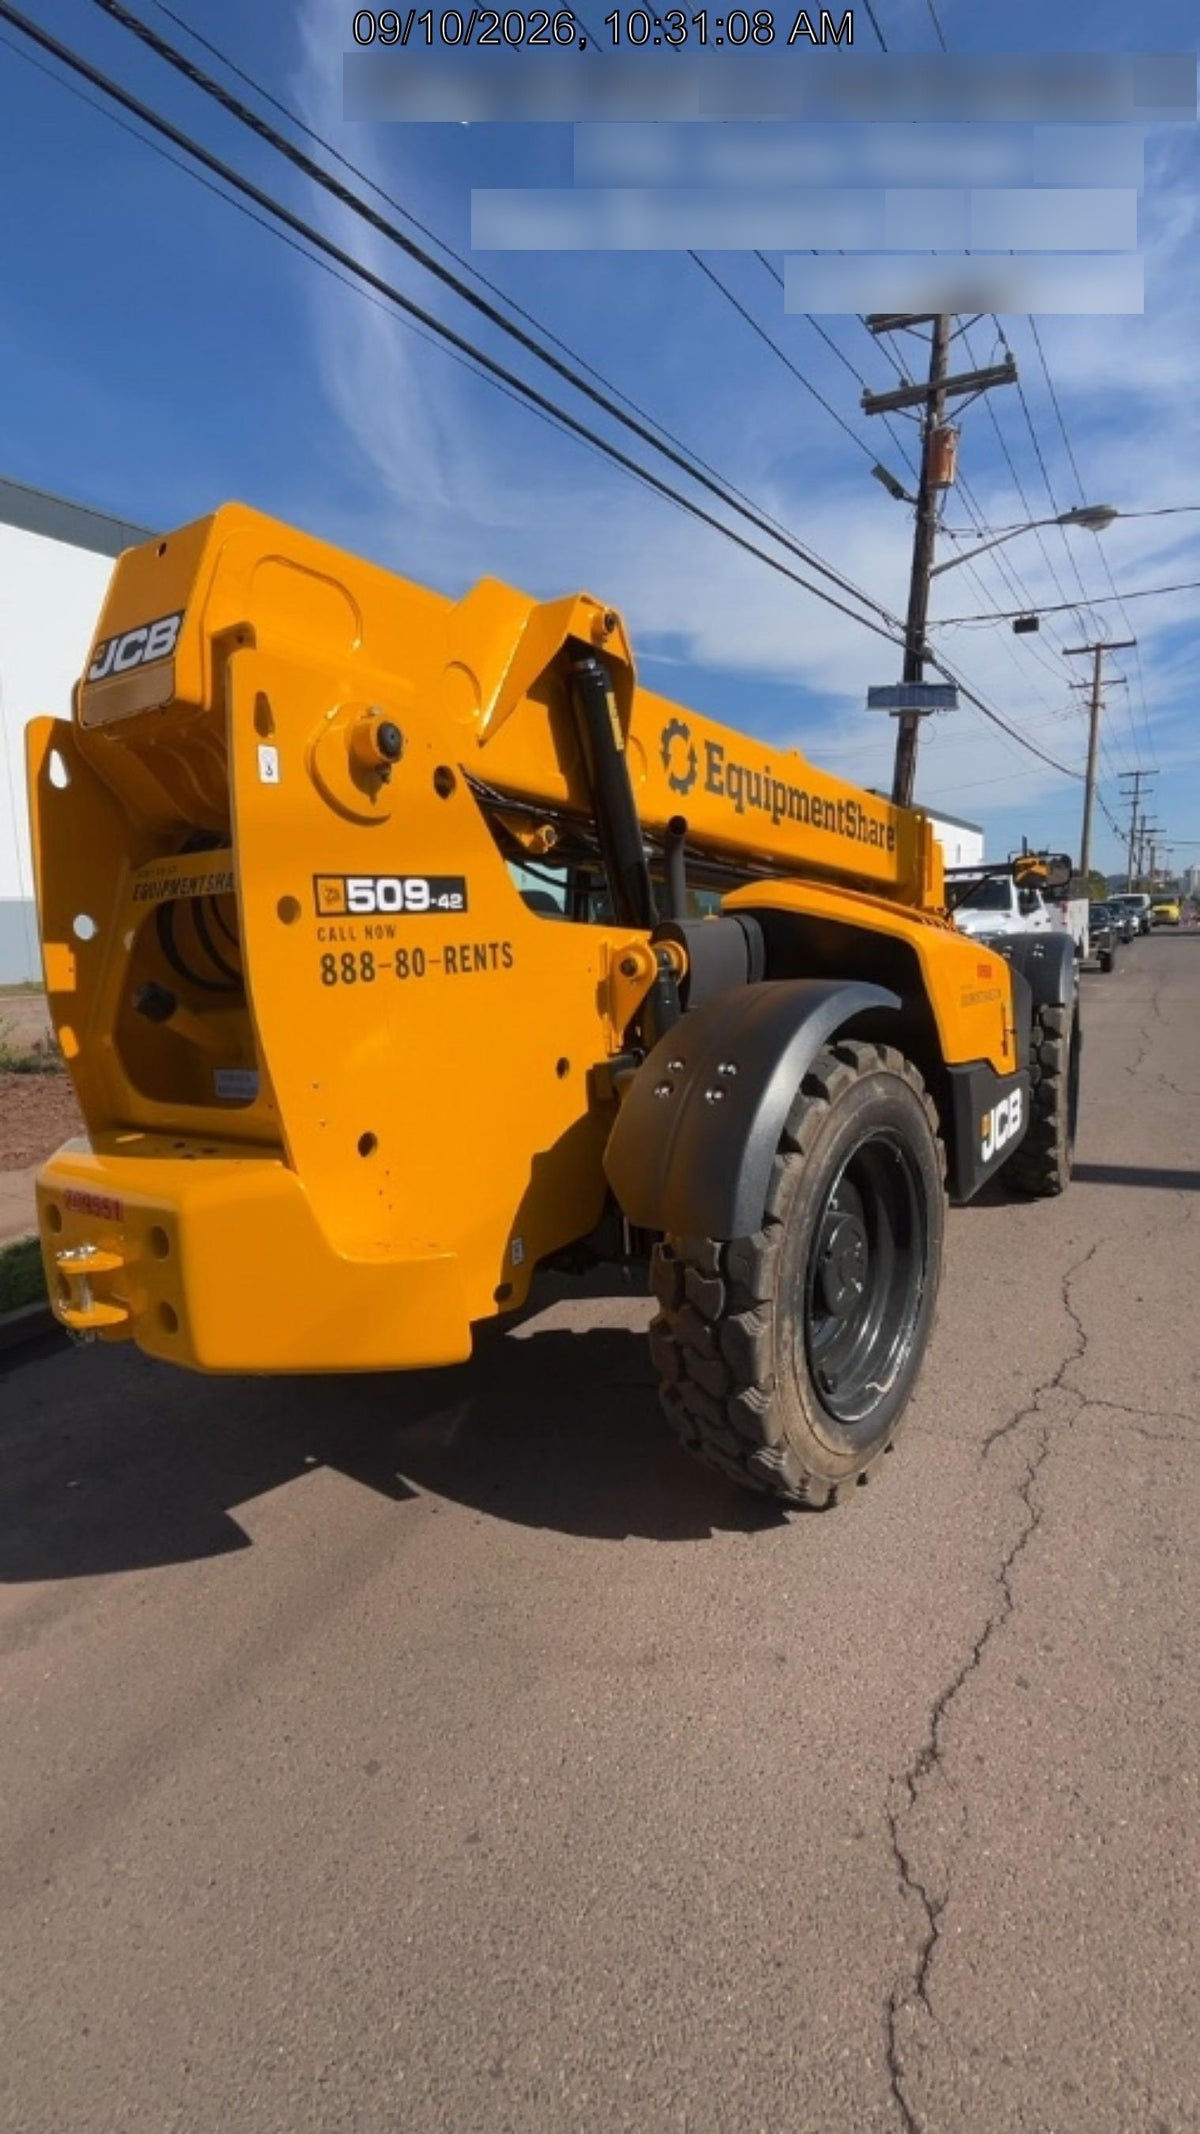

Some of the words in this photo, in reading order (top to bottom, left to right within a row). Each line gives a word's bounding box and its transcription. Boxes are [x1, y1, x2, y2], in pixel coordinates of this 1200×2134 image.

[89, 615, 180, 681] JCB
[703, 739, 896, 853] EquipmentShare
[317, 926, 357, 942] CALL
[365, 924, 396, 940] NOW
[321, 942, 514, 987] 888-80-RENTS
[981, 1087, 1022, 1163] JCB
